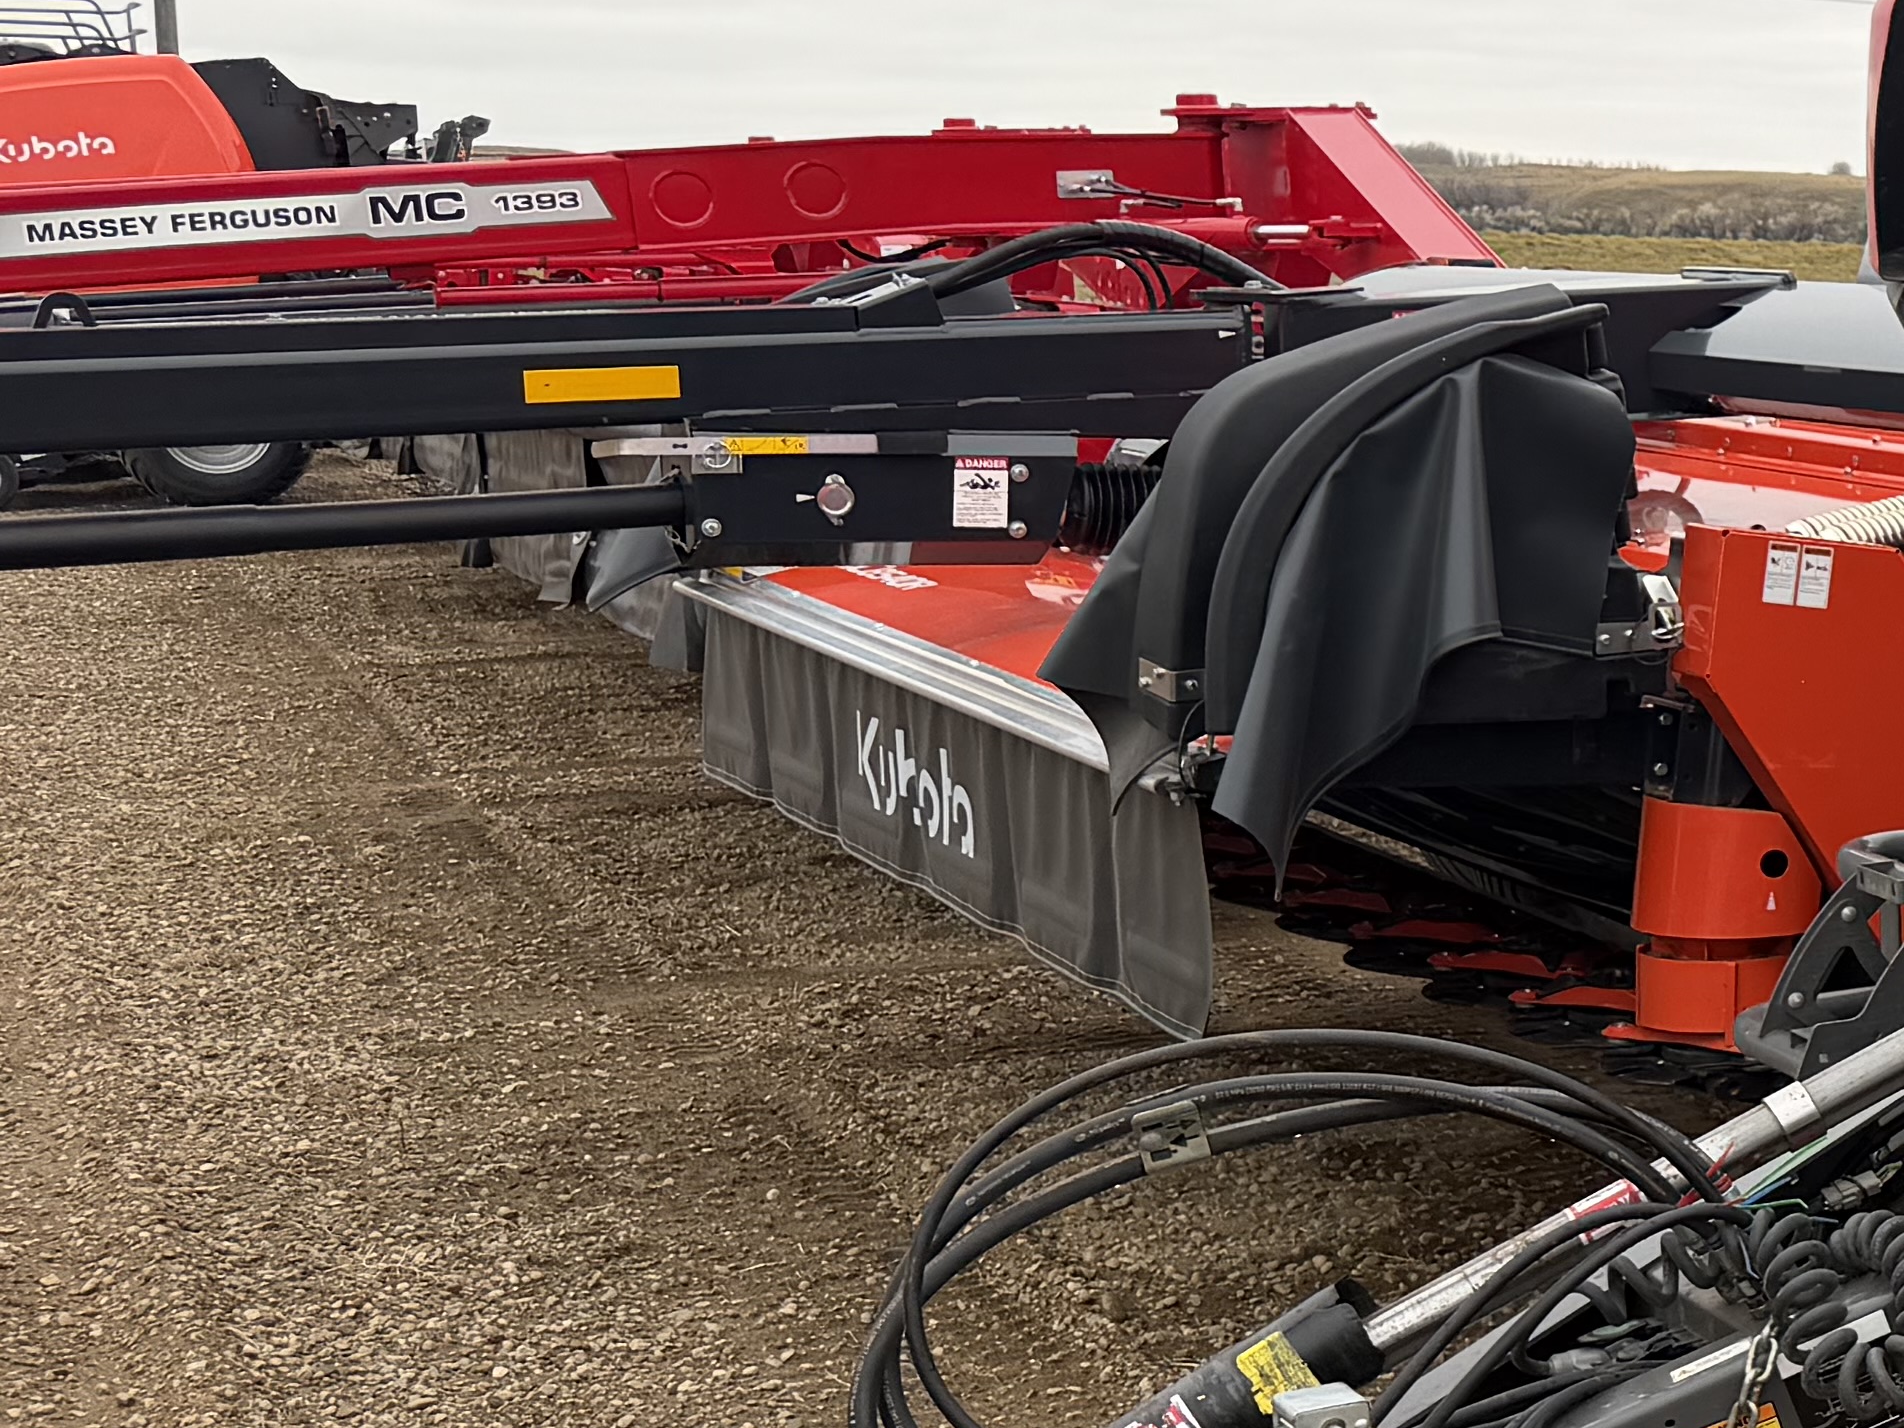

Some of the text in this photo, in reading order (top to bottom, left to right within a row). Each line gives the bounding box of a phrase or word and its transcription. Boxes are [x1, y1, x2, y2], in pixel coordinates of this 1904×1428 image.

[26, 191, 580, 243] MASSEY FERGUSON MC 1393
[965, 458, 1007, 469] DANGER
[855, 709, 975, 859] Kubota
